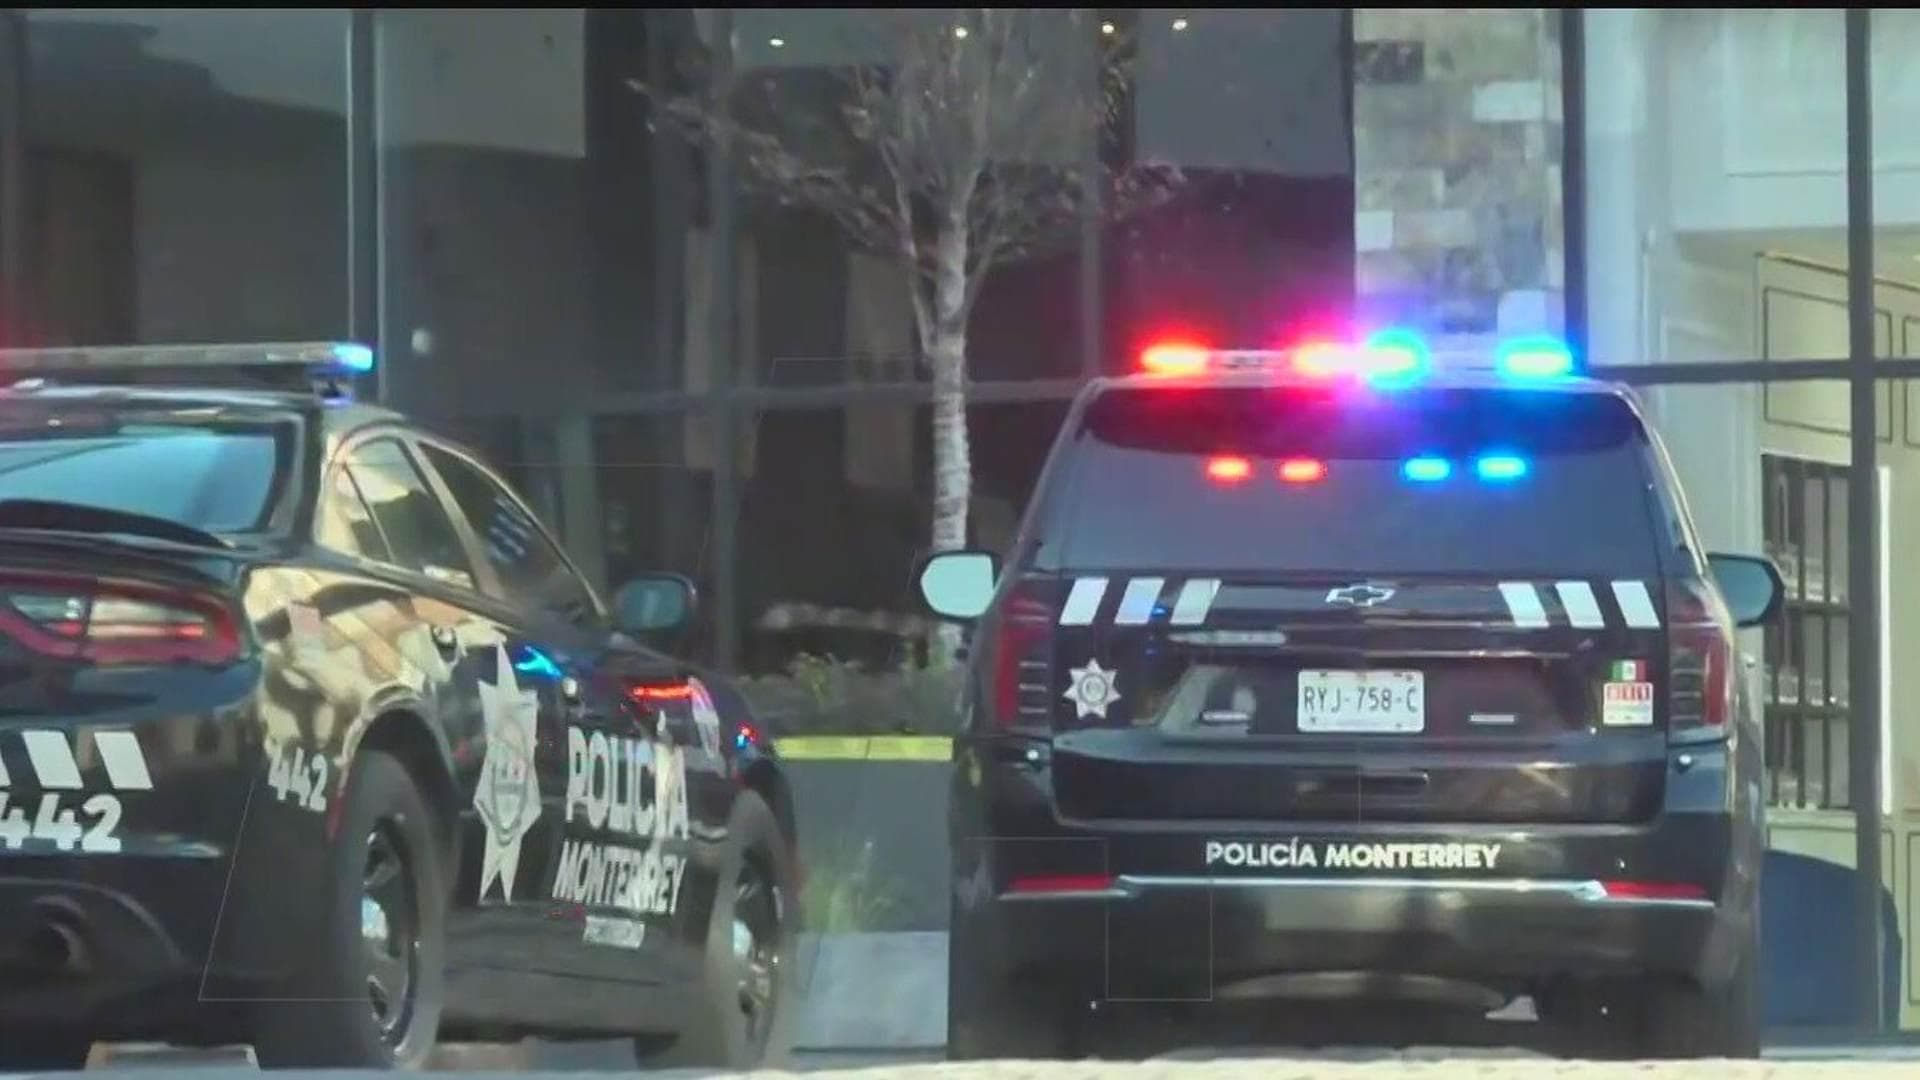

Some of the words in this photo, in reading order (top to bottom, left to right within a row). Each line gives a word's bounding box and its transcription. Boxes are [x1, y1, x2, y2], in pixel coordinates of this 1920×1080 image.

[1303, 685, 1419, 713] RYJ-758-C
[267, 746, 328, 812] 442
[551, 839, 688, 915] MONTERREY
[1206, 836, 1318, 866] POLICÍA
[1324, 843, 1501, 869] MONTERREY
